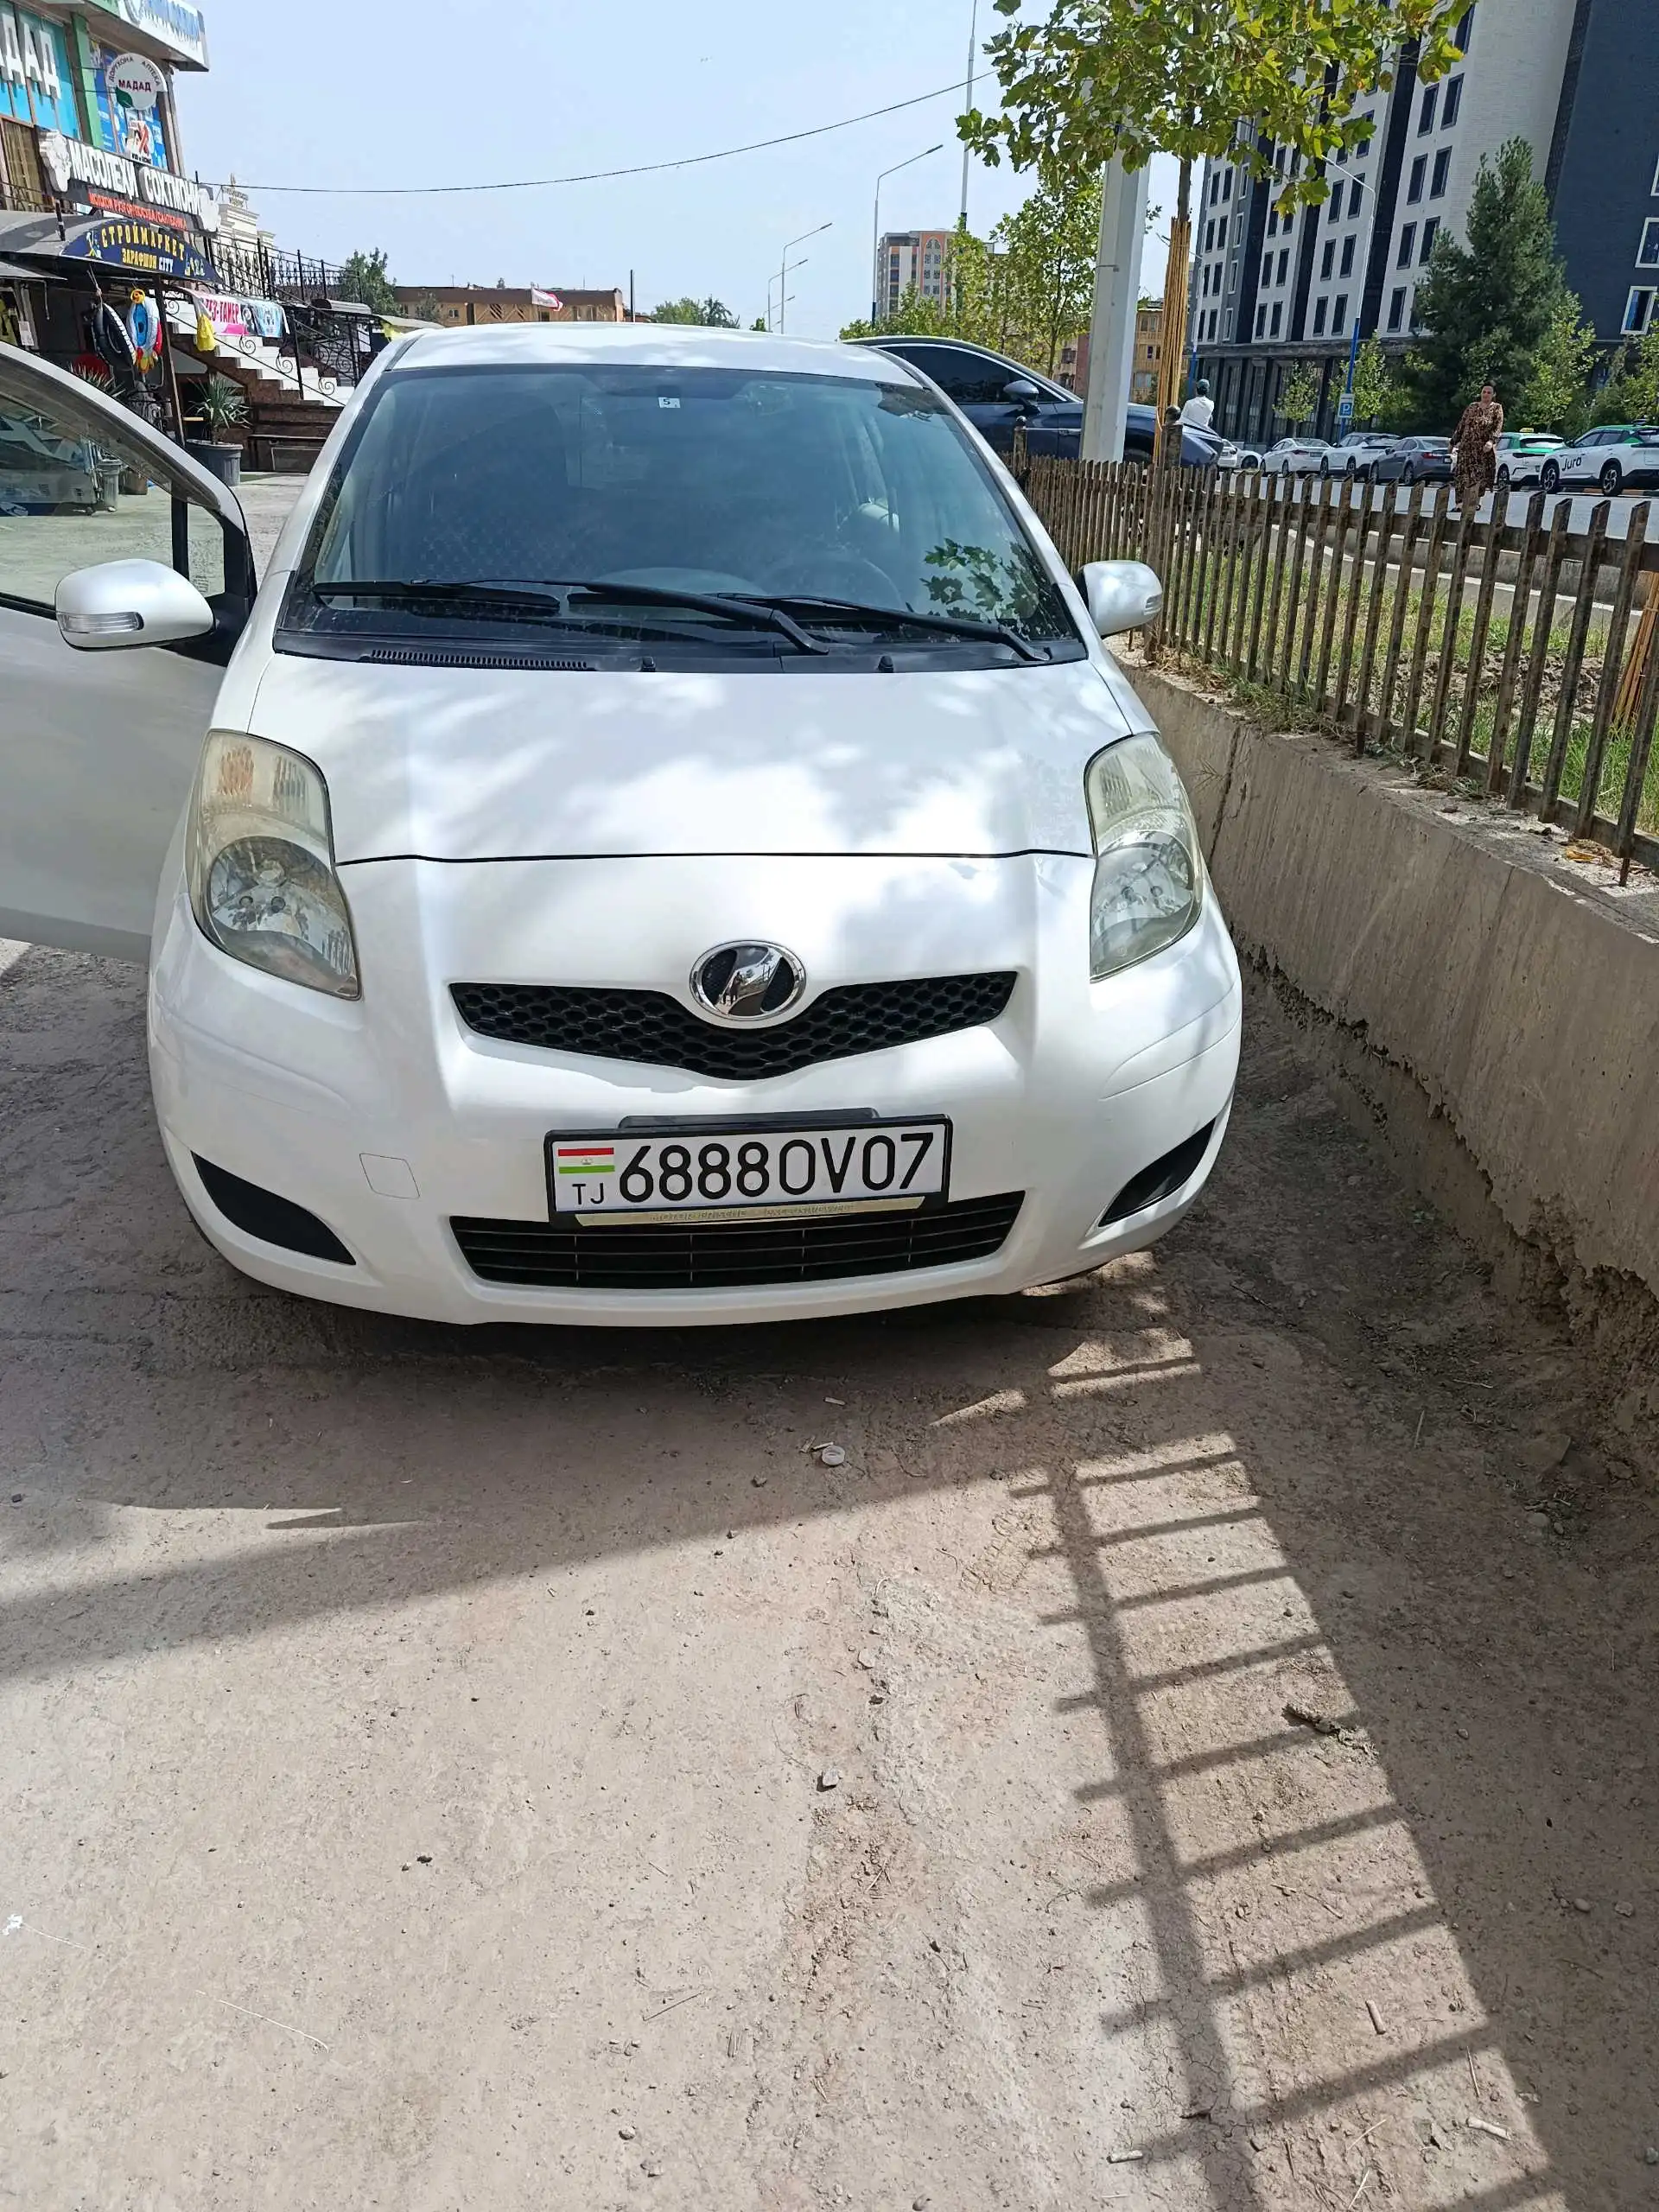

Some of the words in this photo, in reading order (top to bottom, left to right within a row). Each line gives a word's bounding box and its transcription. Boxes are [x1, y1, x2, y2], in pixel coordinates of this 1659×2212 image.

[0, 13, 61, 100] ДАД
[118, 79, 151, 92] МАДАД
[142, 61, 161, 86] АПТЕКА
[101, 222, 185, 261] СТРОЙМАРКЕТ
[122, 248, 157, 269] ЗАРАФШОН
[159, 257, 174, 273] CITY
[1561, 455, 1582, 471] Jura
[572, 1183, 605, 1205] TJ
